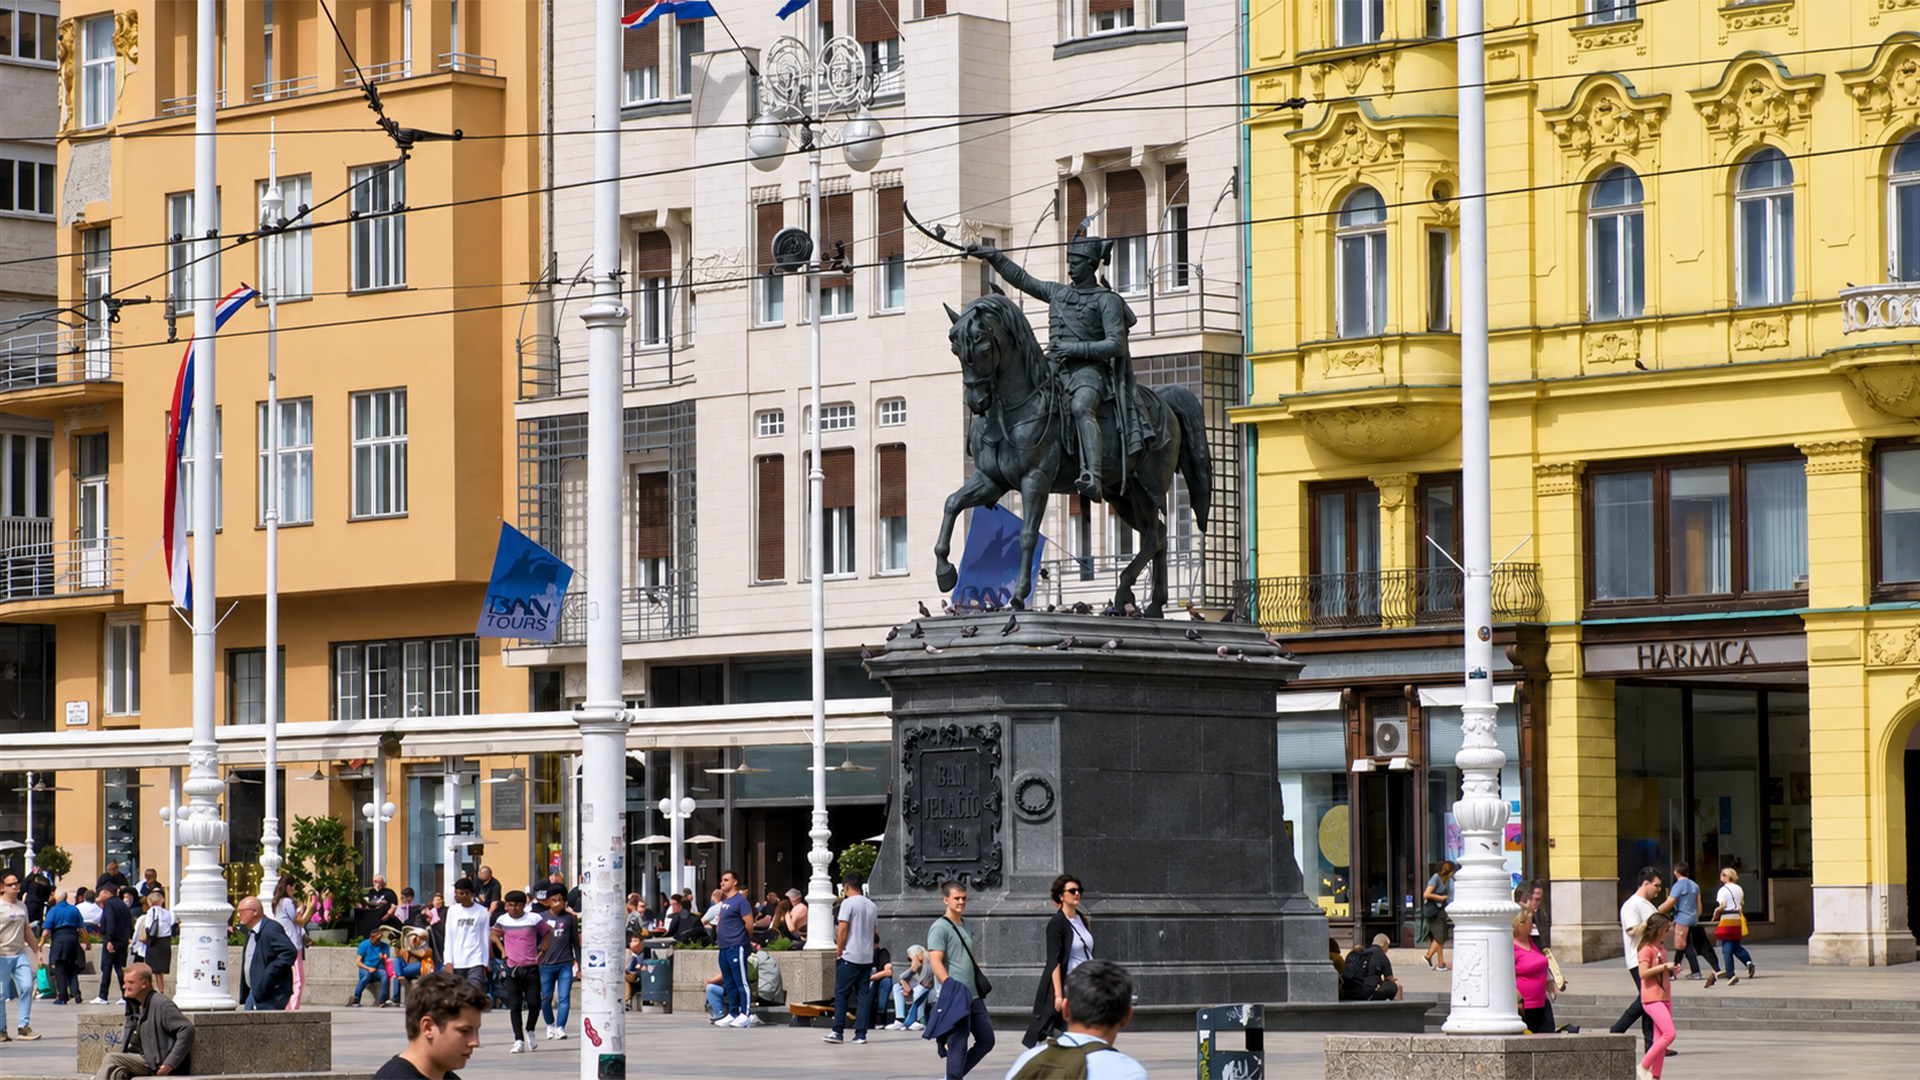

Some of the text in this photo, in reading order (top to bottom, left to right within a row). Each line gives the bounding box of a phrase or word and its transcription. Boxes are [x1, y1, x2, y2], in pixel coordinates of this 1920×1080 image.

[489, 595, 551, 618] BAN
[486, 615, 548, 631] TOURS
[1636, 640, 1759, 669] HARMICA
[936, 763, 967, 788] BAN
